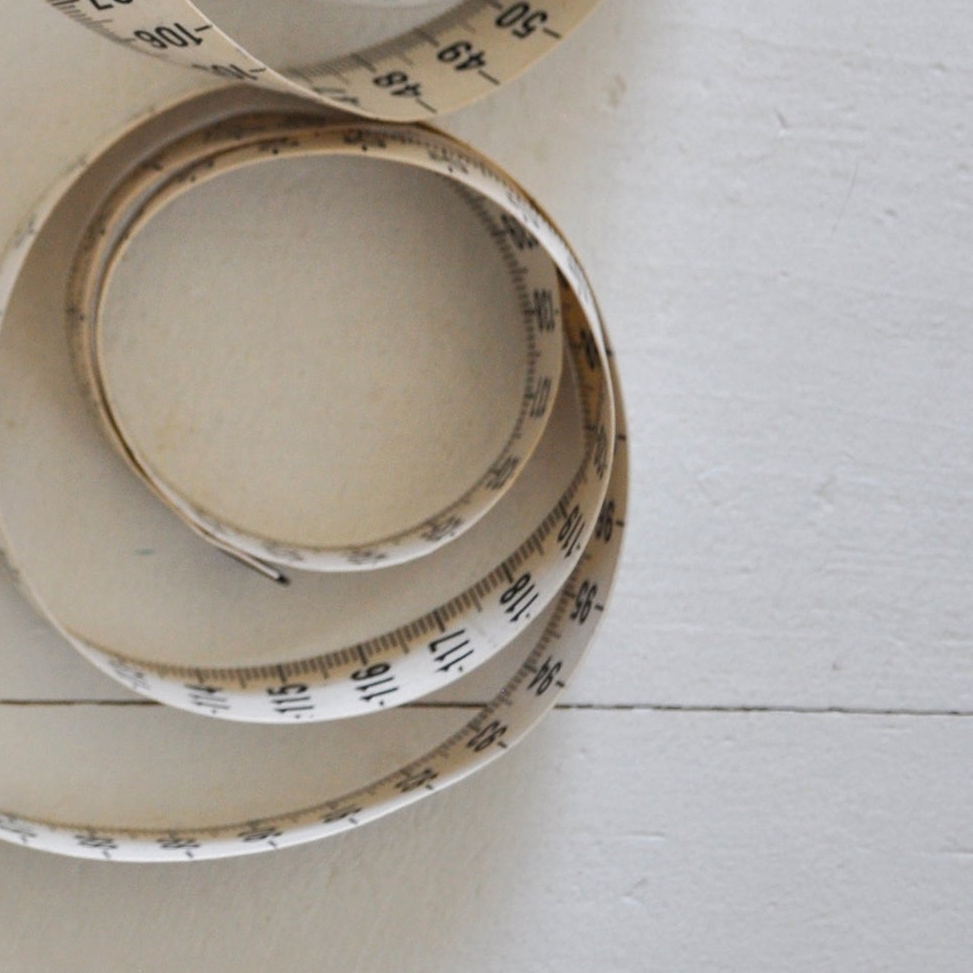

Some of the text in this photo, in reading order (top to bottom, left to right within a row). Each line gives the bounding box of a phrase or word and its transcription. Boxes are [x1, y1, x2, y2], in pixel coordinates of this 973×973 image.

[133, 22, 203, 50] 106
[495, 2, 548, 39] 50
[437, 40, 486, 71] 49
[499, 572, 539, 623] 118
[429, 629, 474, 672] 117
[350, 663, 399, 702] 116
